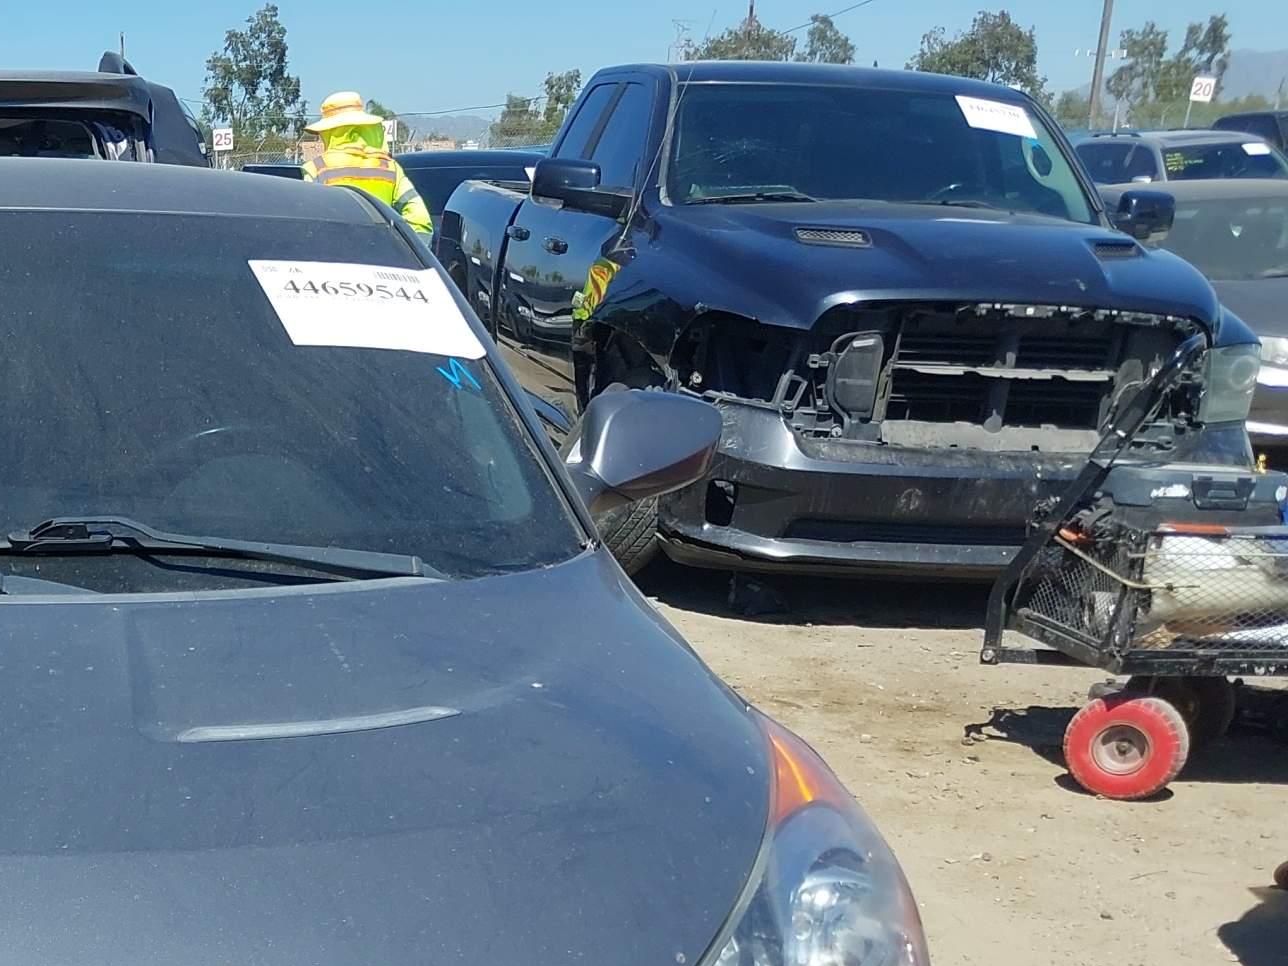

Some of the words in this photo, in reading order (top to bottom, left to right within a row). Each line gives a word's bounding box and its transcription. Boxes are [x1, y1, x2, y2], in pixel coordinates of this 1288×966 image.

[1192, 82, 1212, 97] 20
[214, 133, 233, 147] 25
[283, 279, 430, 304] 44659544
